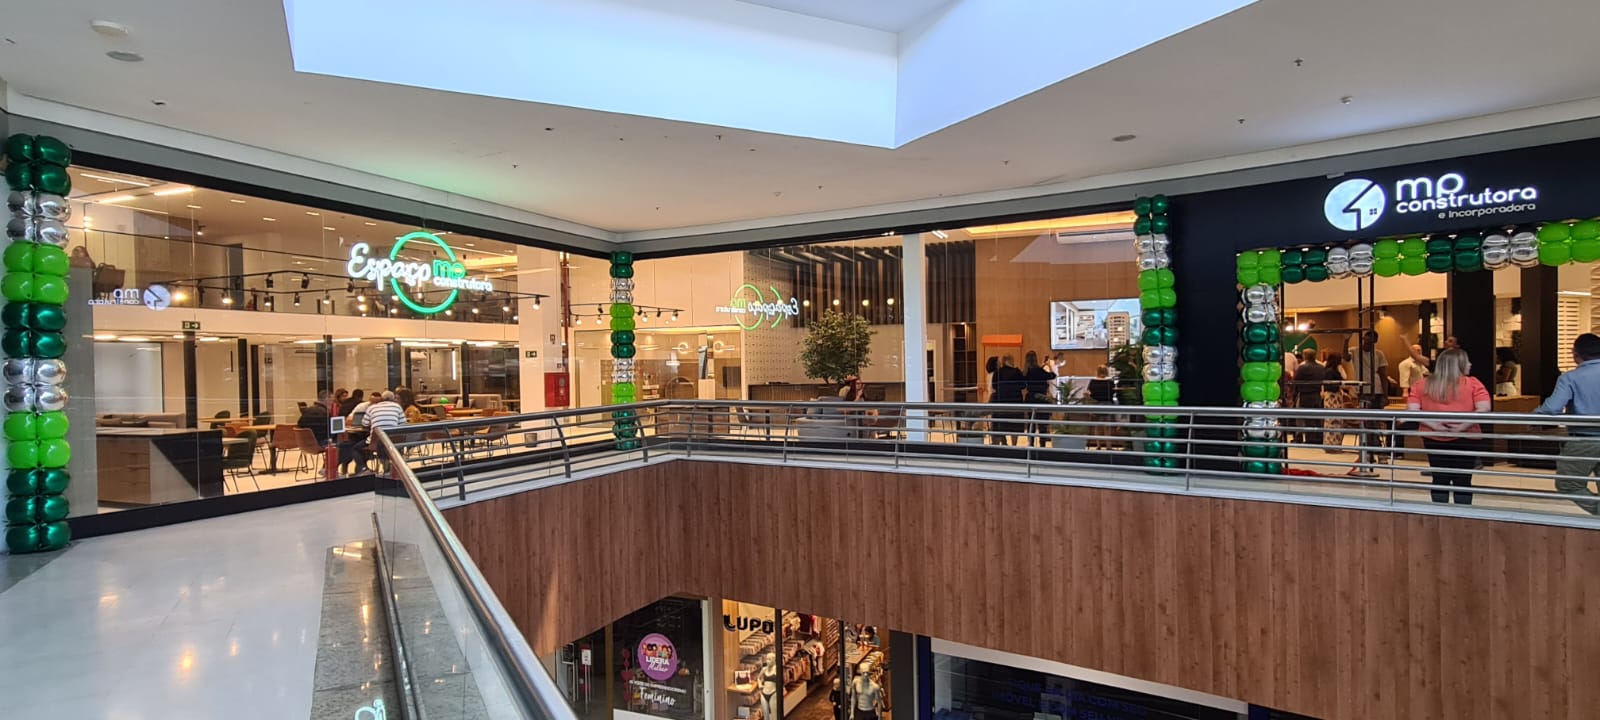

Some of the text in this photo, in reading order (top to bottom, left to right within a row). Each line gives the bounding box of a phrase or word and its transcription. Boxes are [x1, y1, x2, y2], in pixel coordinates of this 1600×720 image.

[1396, 173, 1465, 201] mp
[1396, 186, 1538, 213] construtora
[347, 242, 432, 292] Espaço
[433, 275, 494, 292] construtora
[723, 614, 775, 635] LUPO
